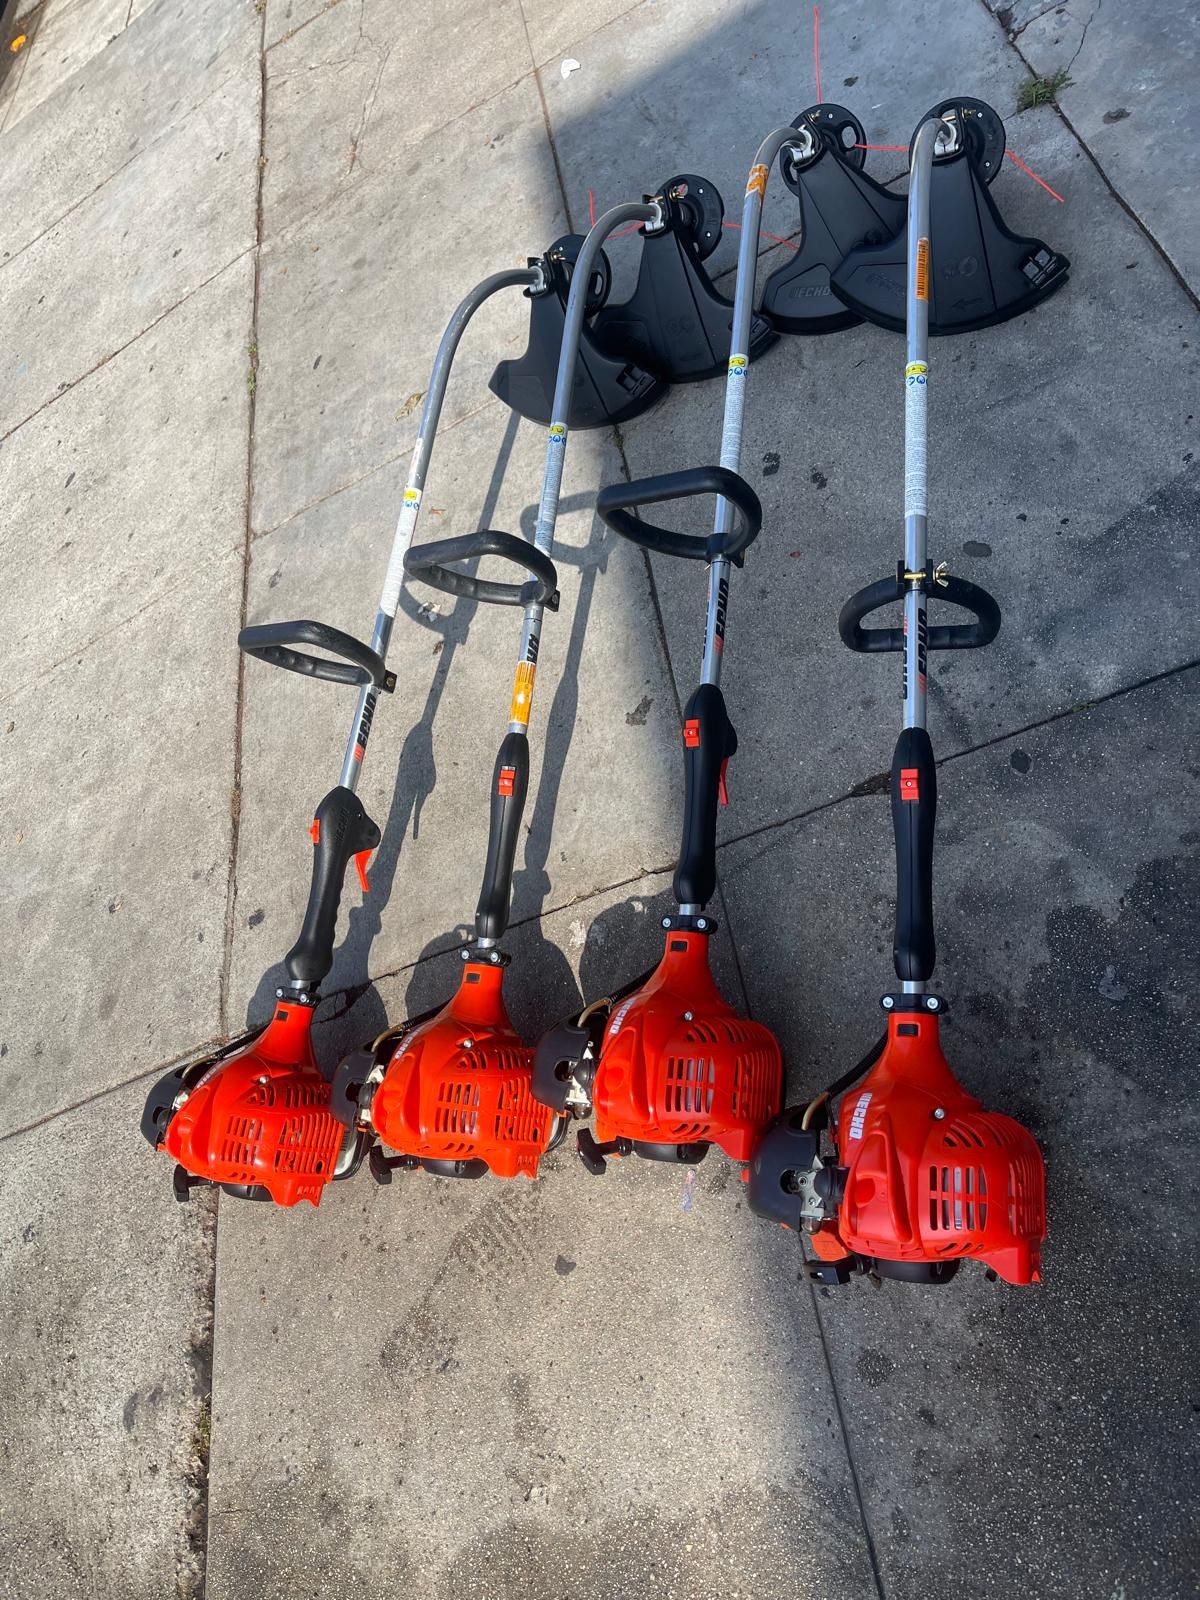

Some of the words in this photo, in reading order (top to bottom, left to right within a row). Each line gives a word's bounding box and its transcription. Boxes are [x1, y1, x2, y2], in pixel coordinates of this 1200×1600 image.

[715, 577, 729, 640] ECHO
[356, 692, 377, 750] ECHO
[609, 1002, 632, 1035] ECHO
[849, 1100, 870, 1140] ECHO
